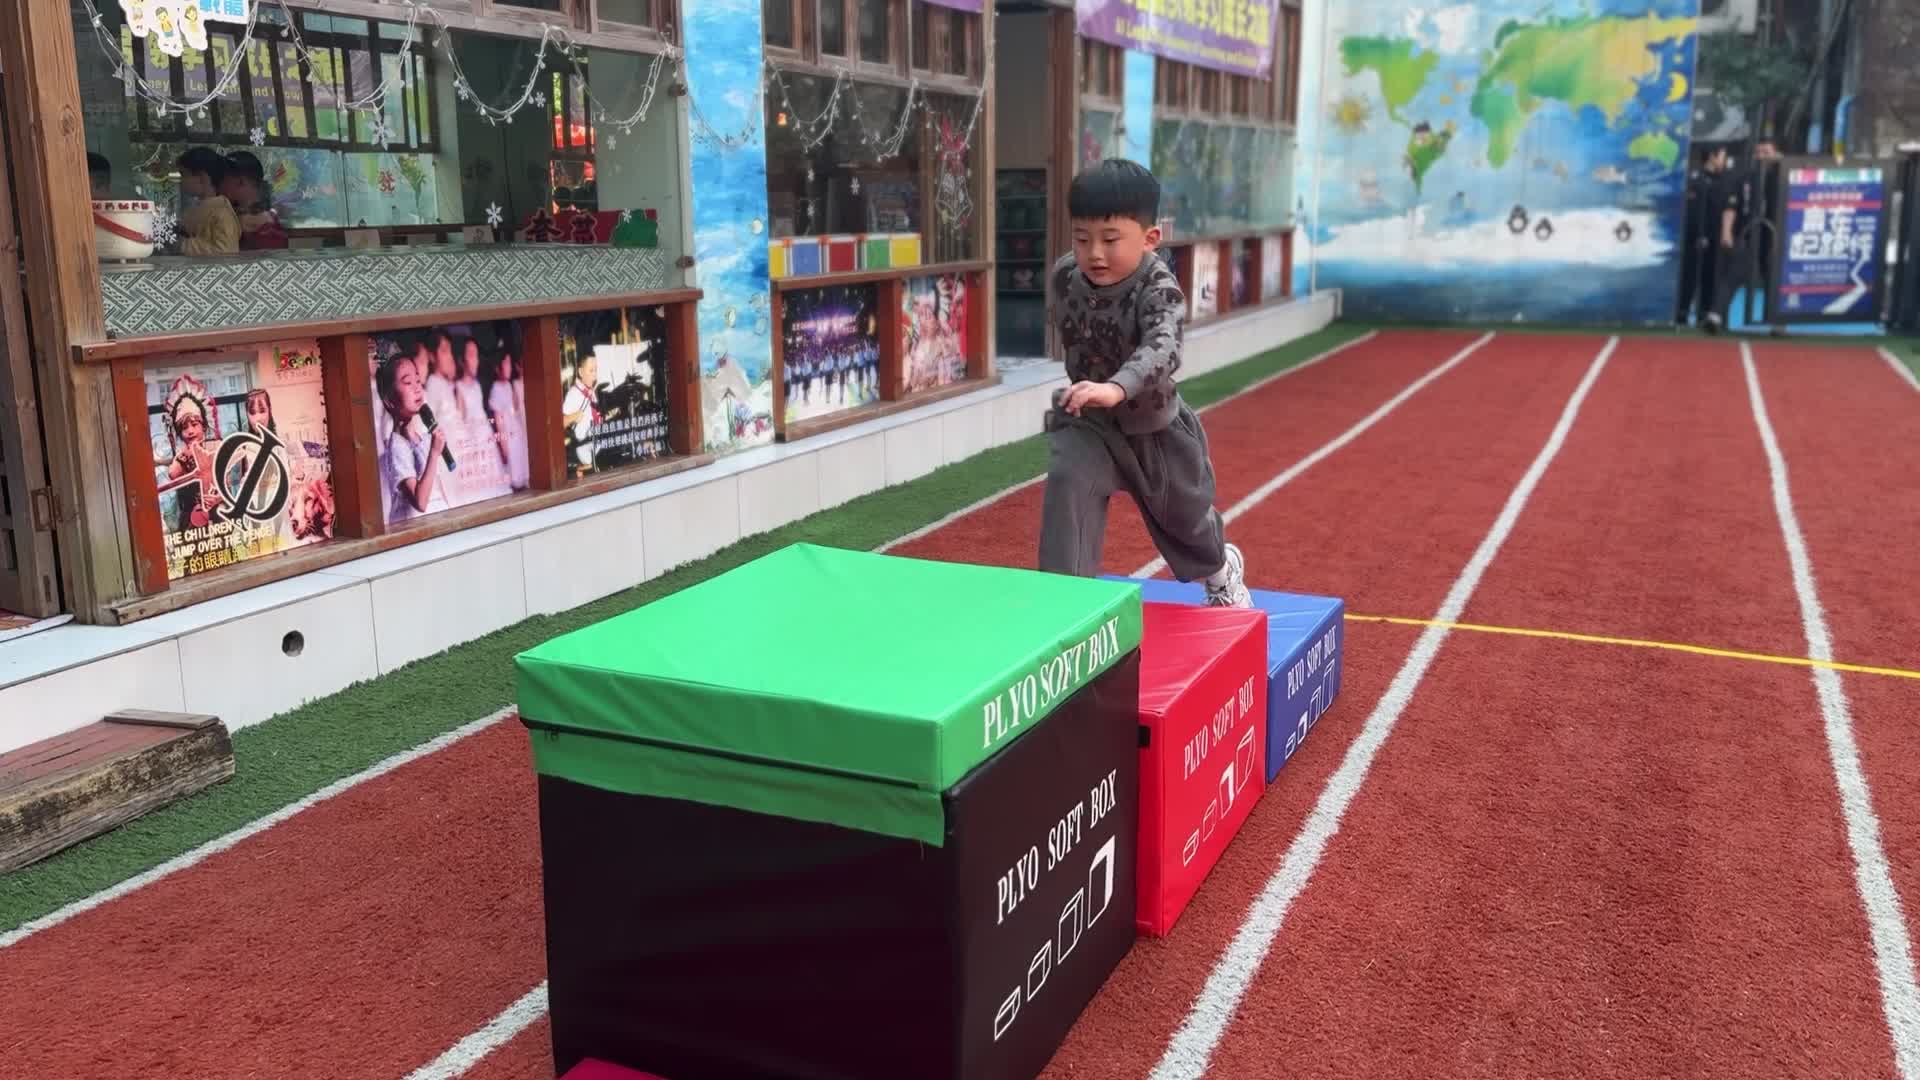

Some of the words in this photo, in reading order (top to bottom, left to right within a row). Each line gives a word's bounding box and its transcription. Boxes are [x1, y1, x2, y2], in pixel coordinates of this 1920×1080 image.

[171, 544, 196, 561] JUMP
[198, 539, 222, 554] OVER
[224, 533, 242, 549] THE
[984, 674, 1037, 749] PLYO
[1040, 640, 1087, 708] SOFT
[1087, 616, 1120, 676] BOX
[1306, 639, 1322, 679] SOFT
[1183, 724, 1209, 781] PLYO
[1212, 695, 1235, 748] SOFT
[1239, 674, 1255, 720] BOX
[997, 845, 1039, 926] PLYO
[1048, 801, 1084, 872] SOFT
[1090, 768, 1117, 829] BOX
